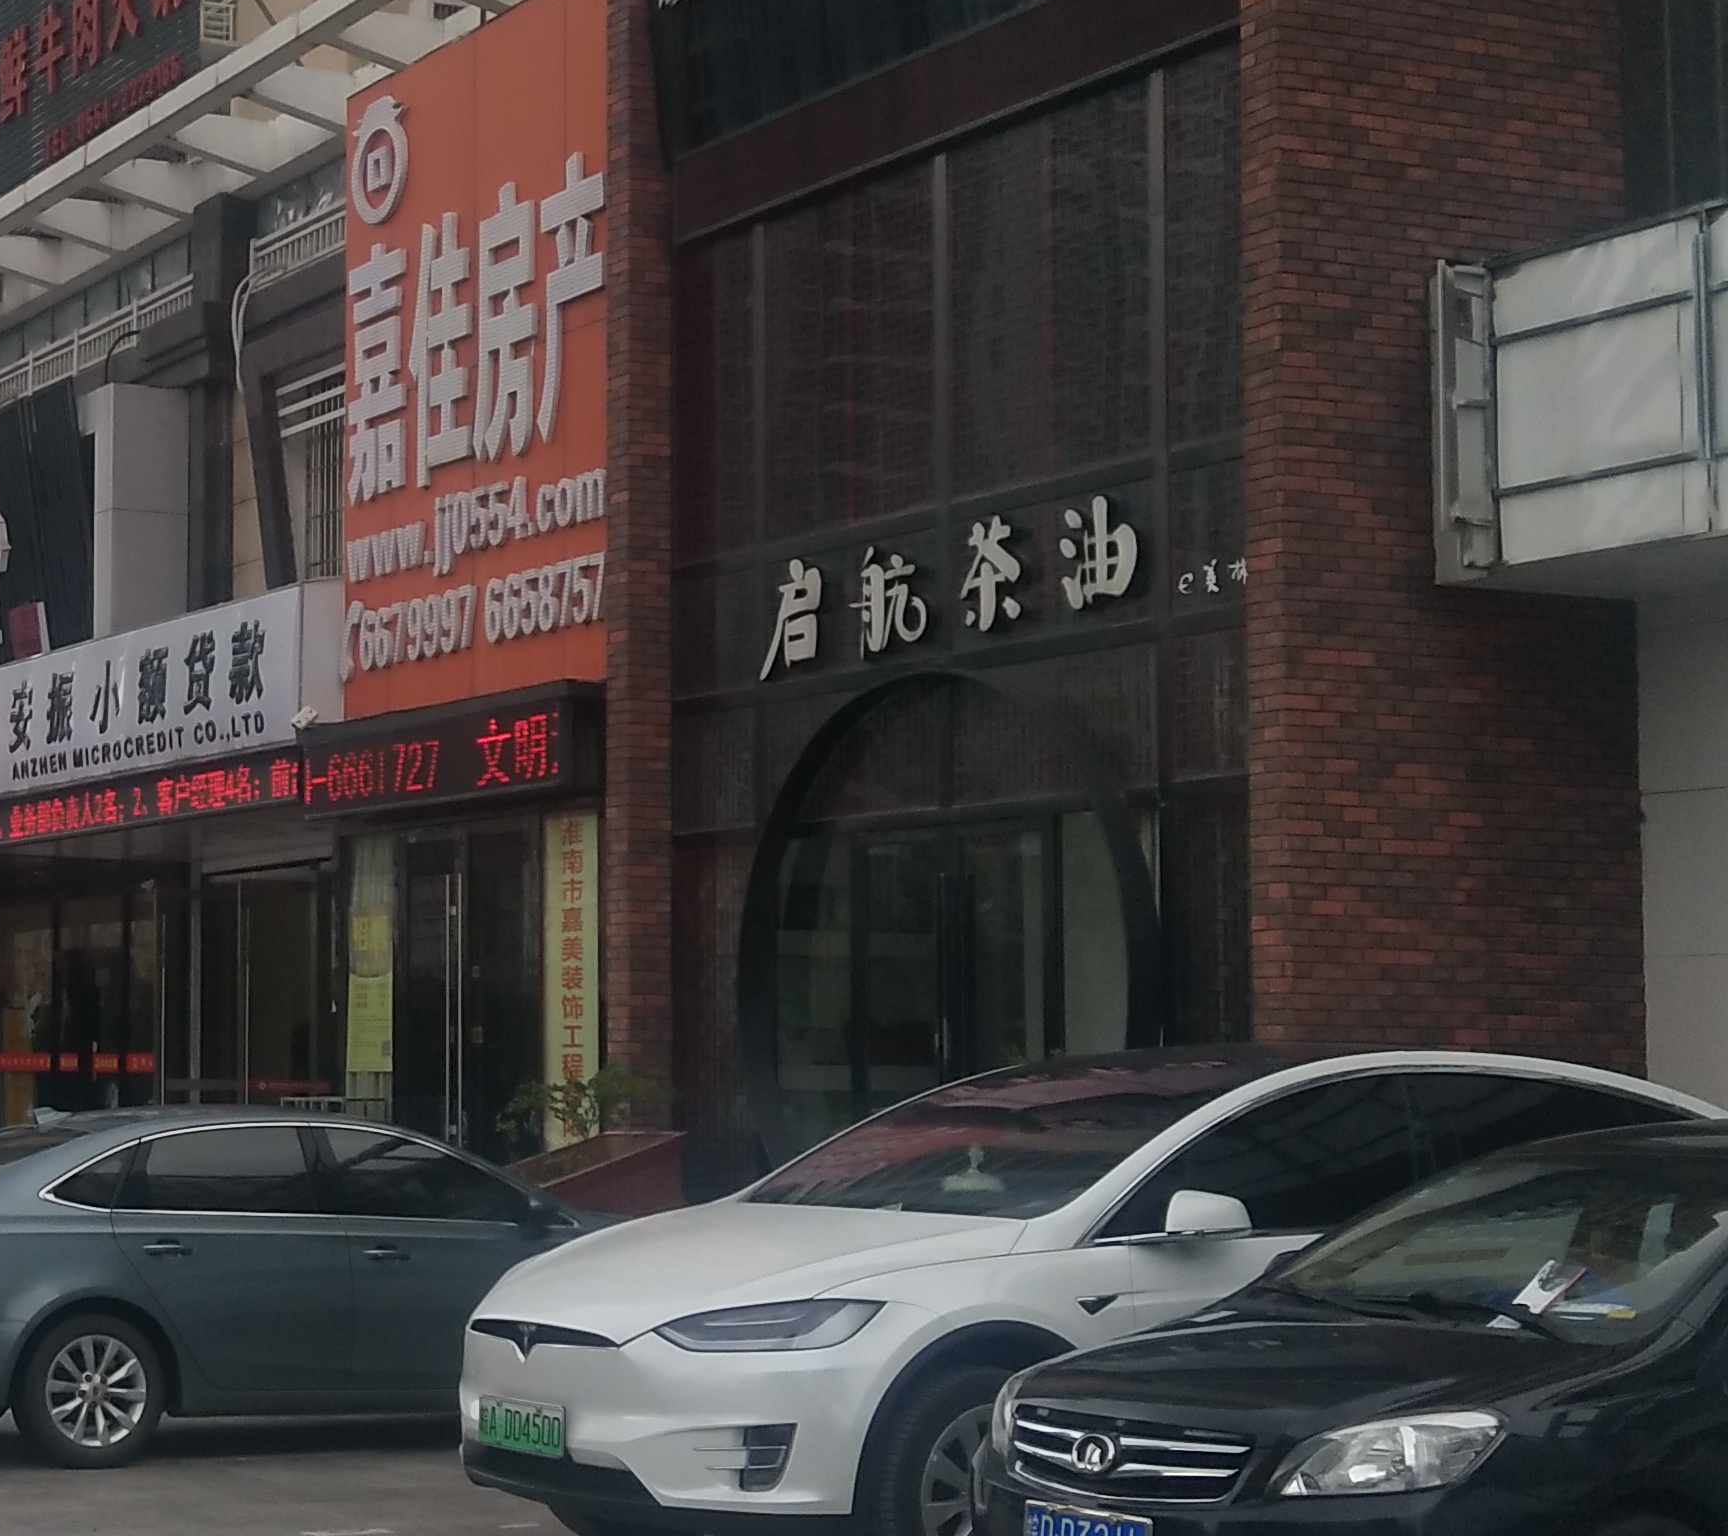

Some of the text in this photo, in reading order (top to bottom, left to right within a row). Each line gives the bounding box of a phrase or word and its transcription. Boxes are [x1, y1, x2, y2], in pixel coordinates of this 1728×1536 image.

[347, 151, 606, 507] 嘉佳房产
[347, 468, 607, 583] www.jj0554.com
[758, 494, 1139, 682] 启航茶油
[359, 551, 606, 671] 6679997 6658757
[8, 618, 267, 754] 安振小额贷款
[12, 710, 266, 781] ANZHEN MICROCREDIT CO.,LTD
[476, 712, 559, 788] 文明
[561, 820, 584, 1138] 淮南市嘉美装饰工程
